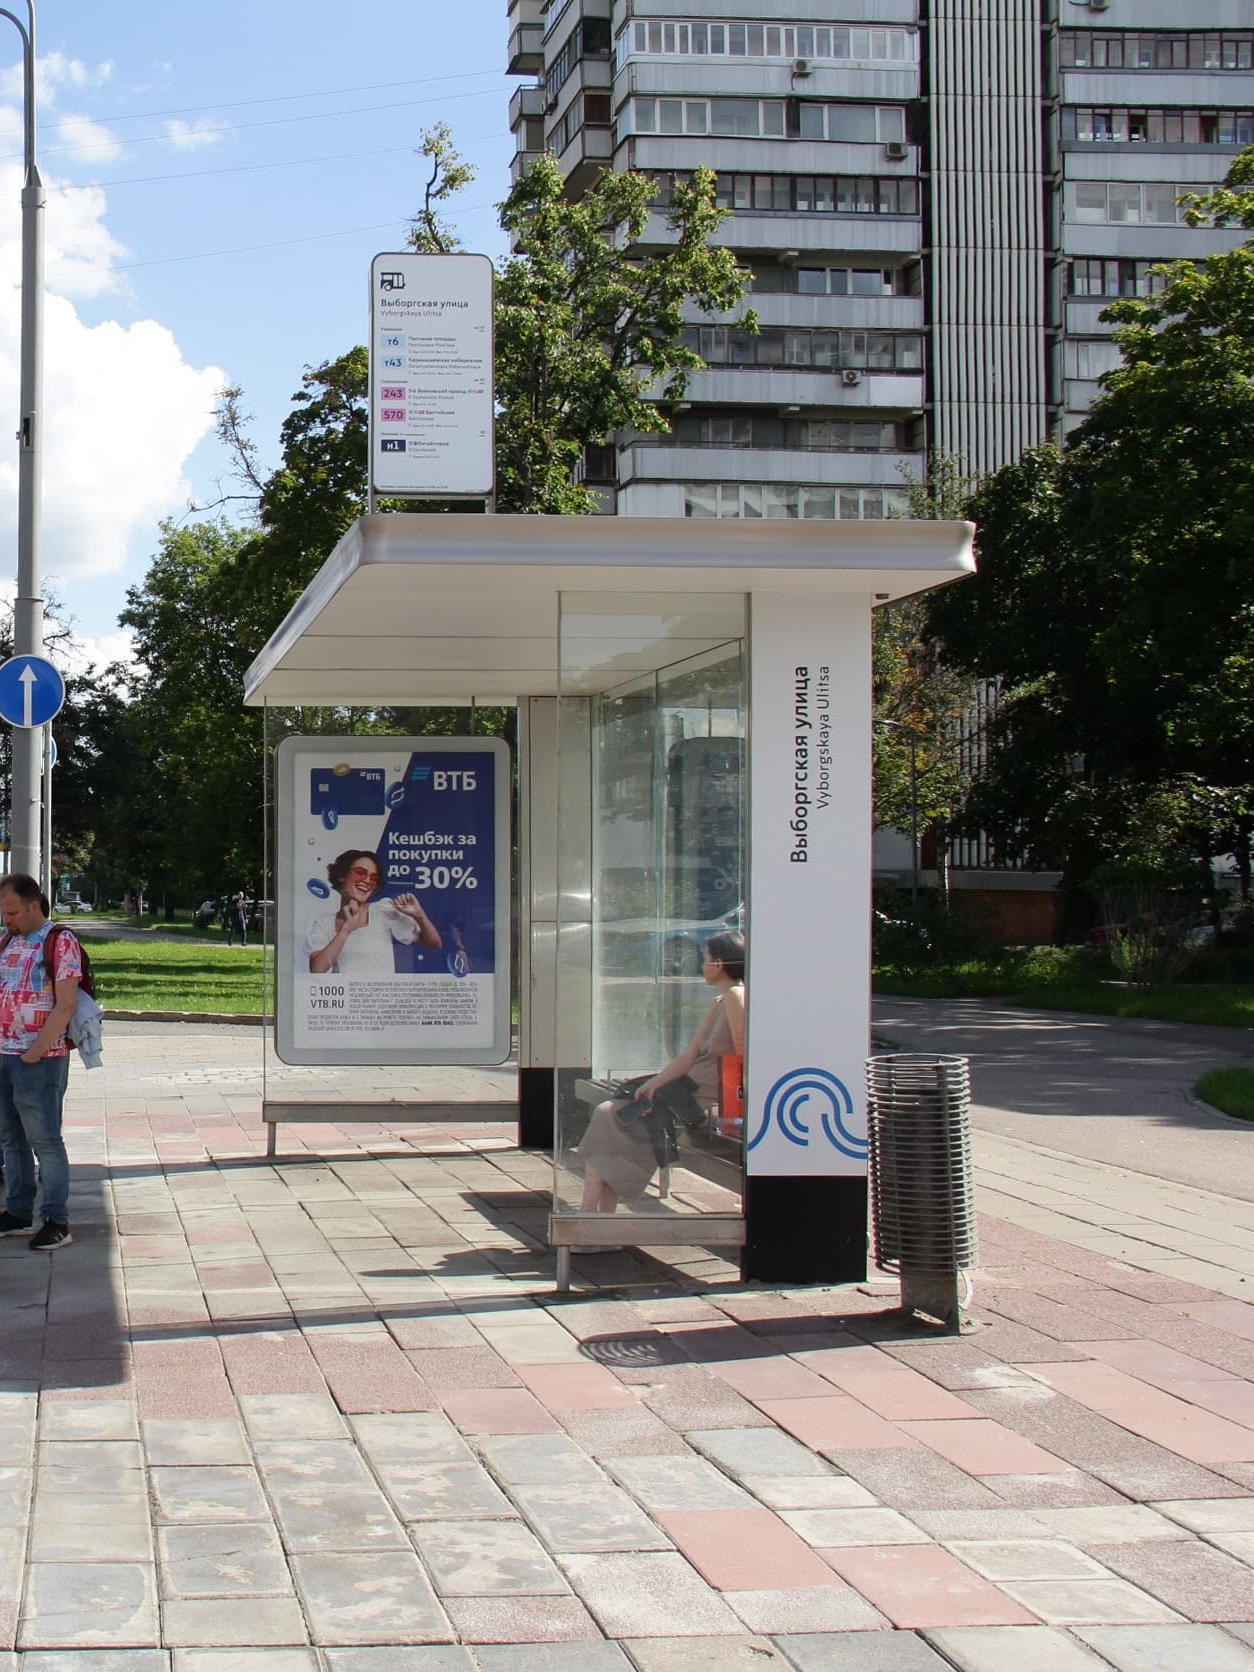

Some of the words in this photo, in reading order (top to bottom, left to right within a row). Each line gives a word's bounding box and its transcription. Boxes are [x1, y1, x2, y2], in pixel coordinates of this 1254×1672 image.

[380, 298, 438, 309] Выборгская
[440, 301, 469, 309] улица
[387, 337, 399, 346] т6
[385, 358, 402, 368] т43
[383, 389, 403, 399] 243
[383, 411, 404, 420] 570
[816, 666, 830, 709] Ulitsa
[795, 666, 812, 729] улица
[816, 714, 832, 809] Vyborgskaya
[366, 772, 382, 781] ВТБ
[433, 771, 477, 791] ВТБ
[790, 735, 812, 863] Выборгская
[388, 831, 454, 845] Кешбэк
[457, 835, 477, 845] за
[388, 850, 464, 863] покупки
[387, 865, 410, 877] до
[415, 866, 478, 889] 30%
[319, 986, 344, 996] 1000
[310, 1000, 344, 1009] VTB.RU
